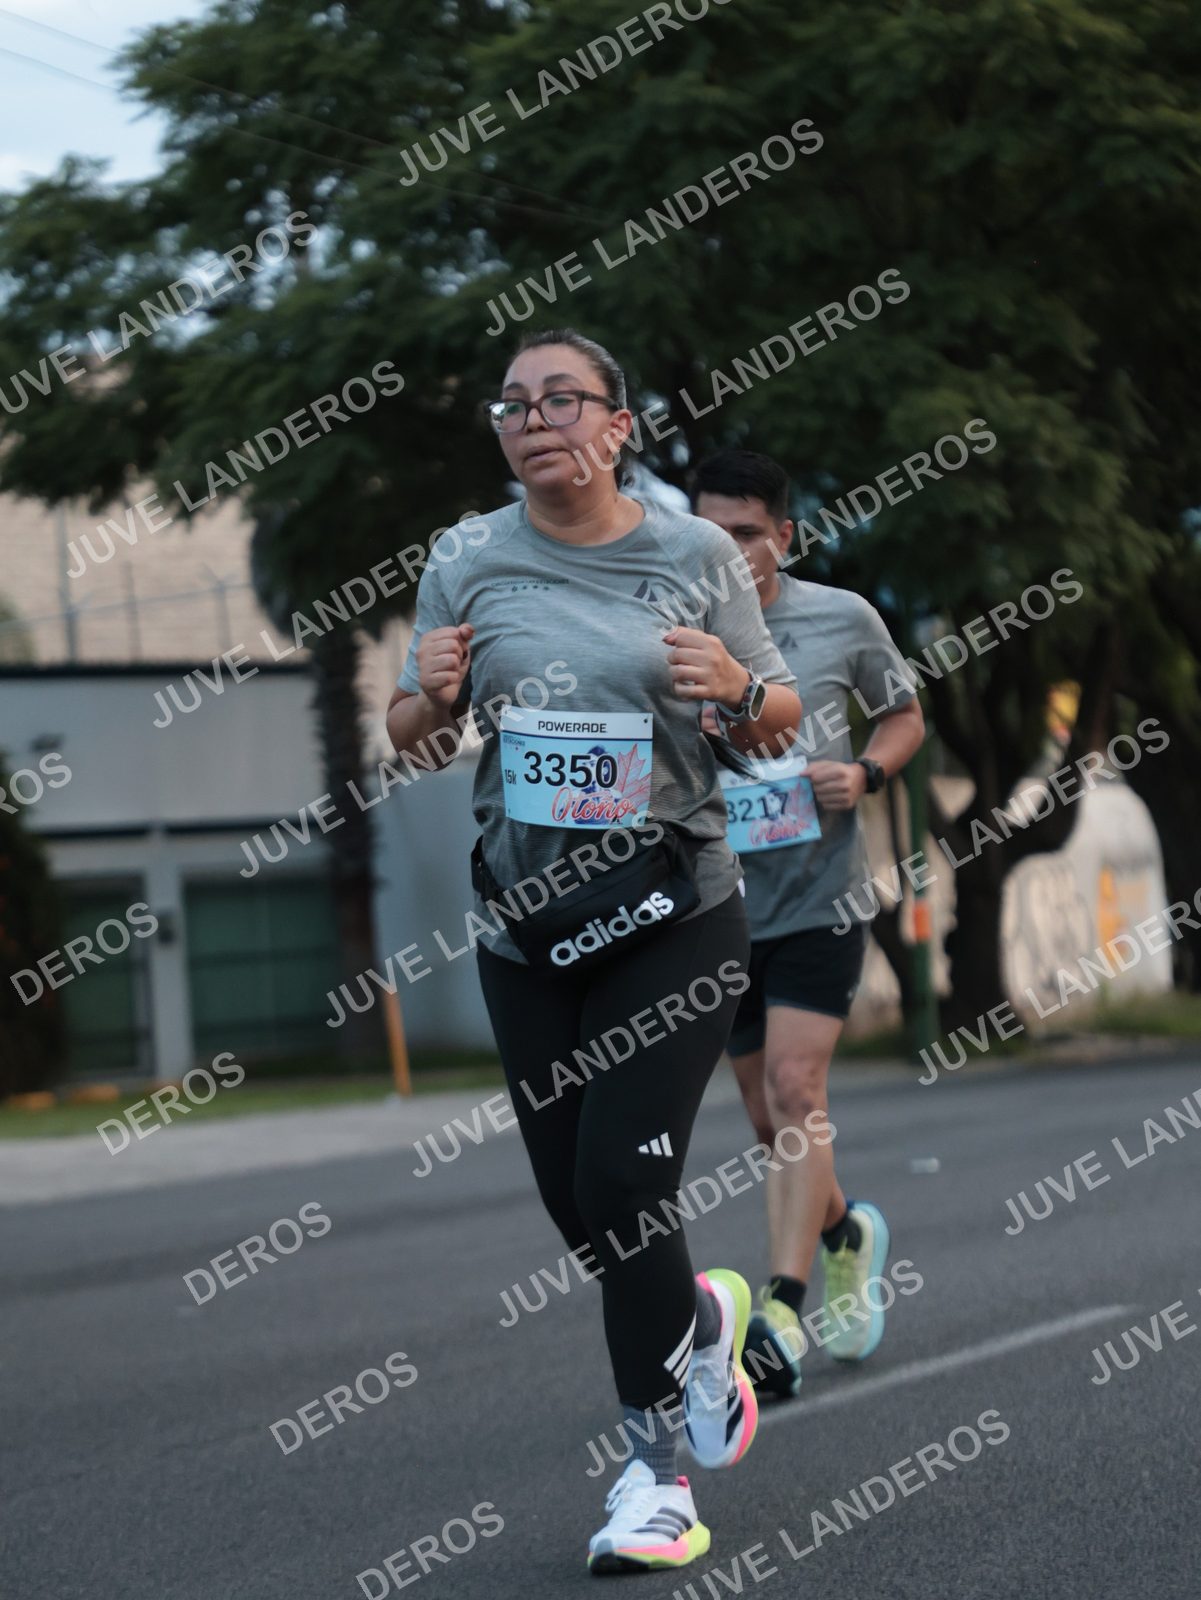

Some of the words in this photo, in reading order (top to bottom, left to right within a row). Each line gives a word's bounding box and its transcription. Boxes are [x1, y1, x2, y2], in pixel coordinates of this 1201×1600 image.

[538, 720, 607, 733] POWERADE
[524, 751, 618, 788] 3350
[550, 892, 675, 966] adidas
